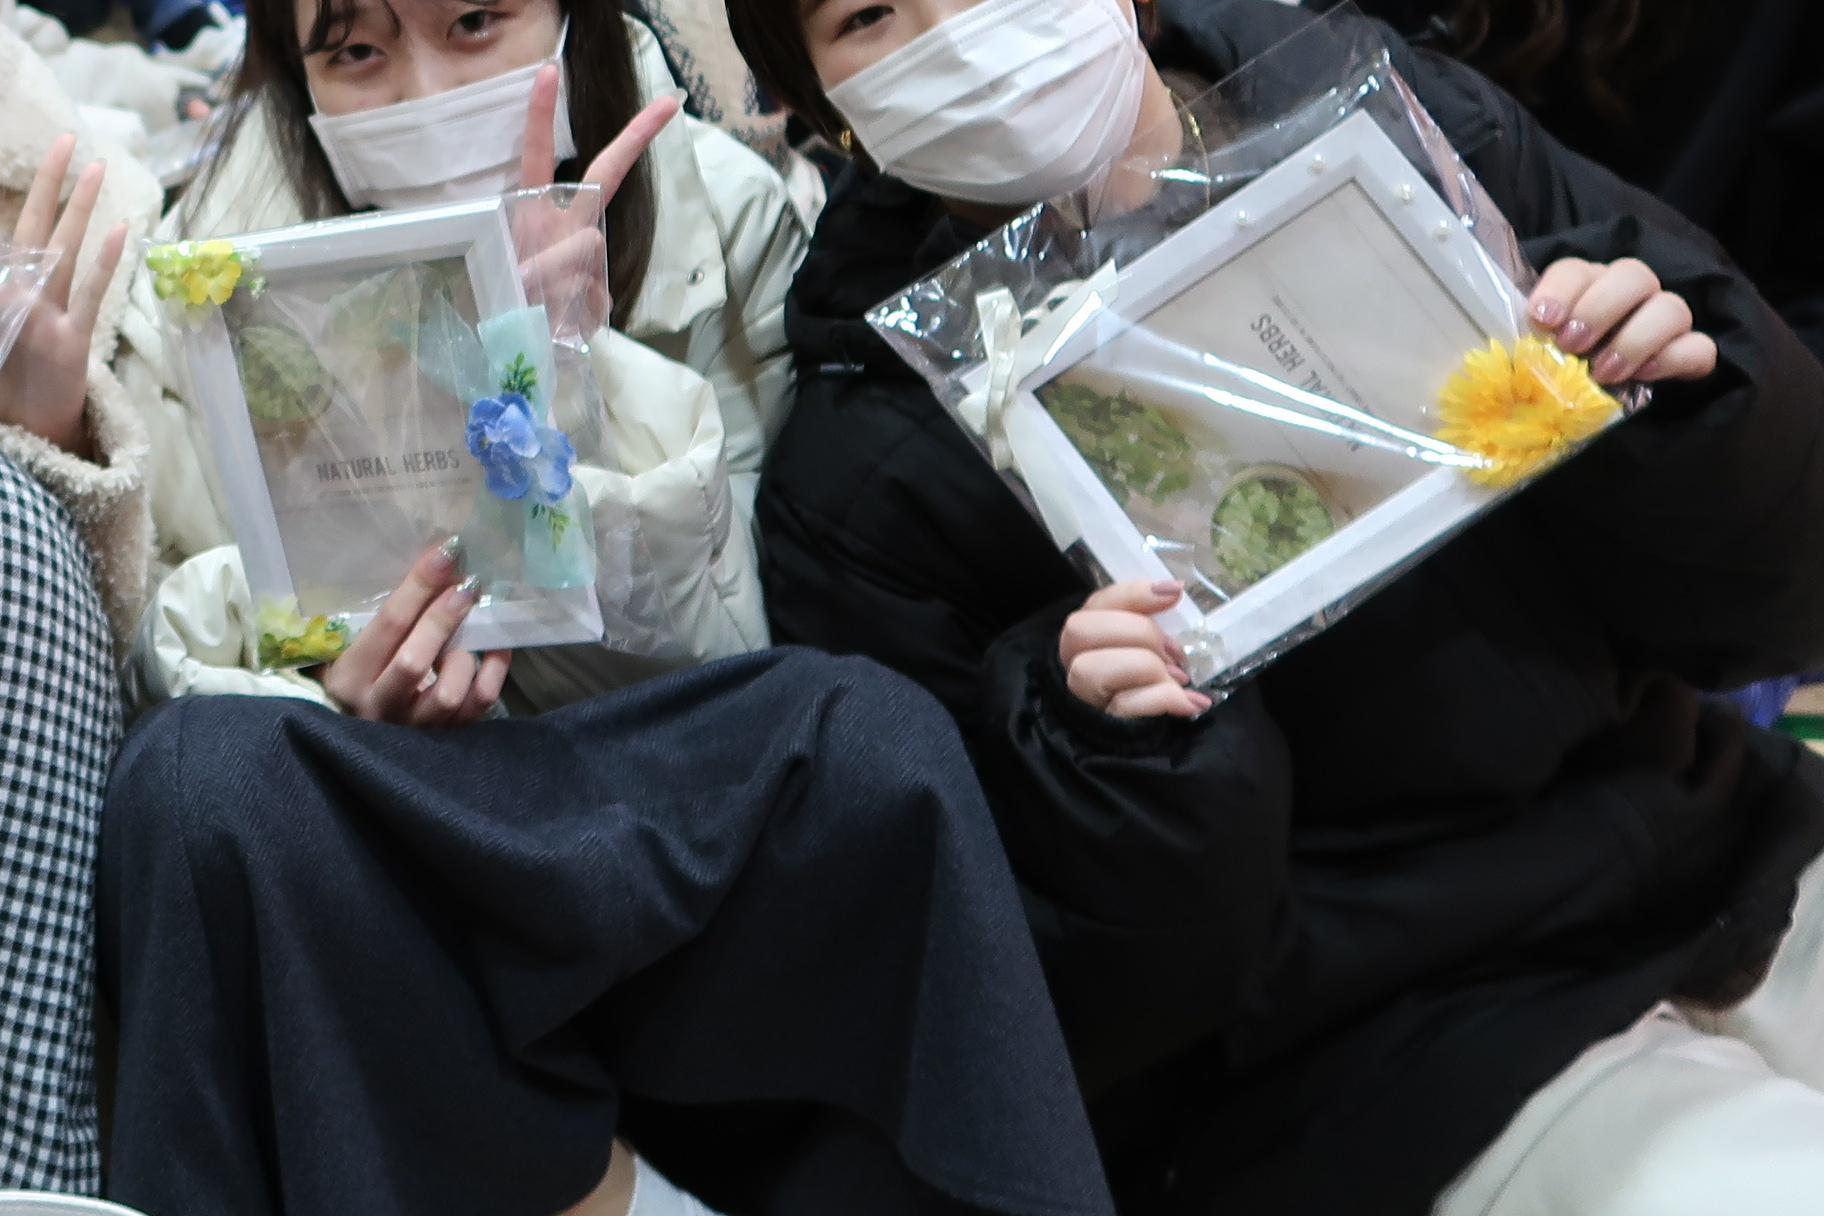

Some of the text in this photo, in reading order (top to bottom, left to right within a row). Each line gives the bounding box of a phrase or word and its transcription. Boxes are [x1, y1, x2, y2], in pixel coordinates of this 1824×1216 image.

[1250, 313, 1306, 373] HERBS
[316, 449, 460, 482] NATURAL HERBS
